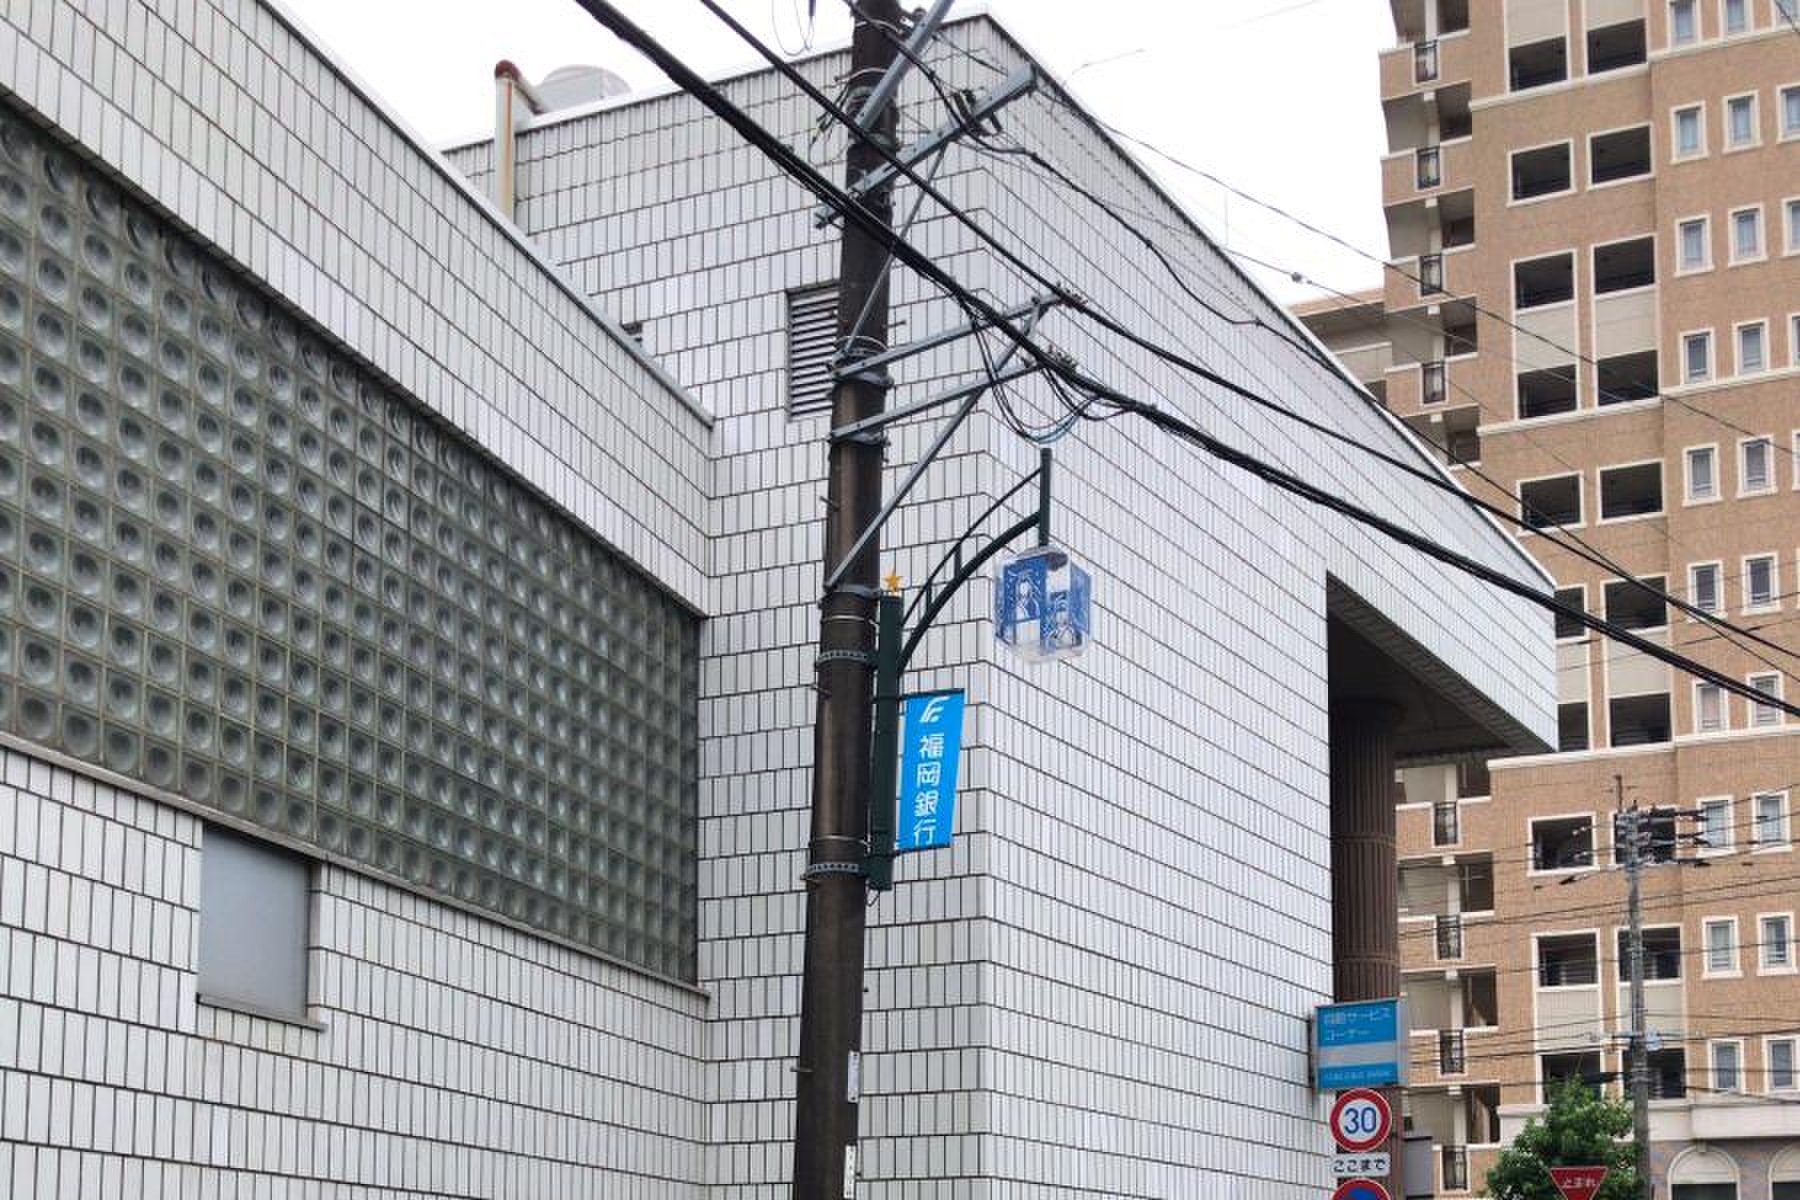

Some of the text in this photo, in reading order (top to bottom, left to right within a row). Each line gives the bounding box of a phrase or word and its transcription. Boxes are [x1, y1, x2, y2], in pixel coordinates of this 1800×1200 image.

[913, 734, 944, 847] 福岡銀行
[1344, 1107, 1377, 1134] 30
[1333, 1158, 1386, 1172] ここまで
[1561, 1176, 1600, 1189] とまれ
